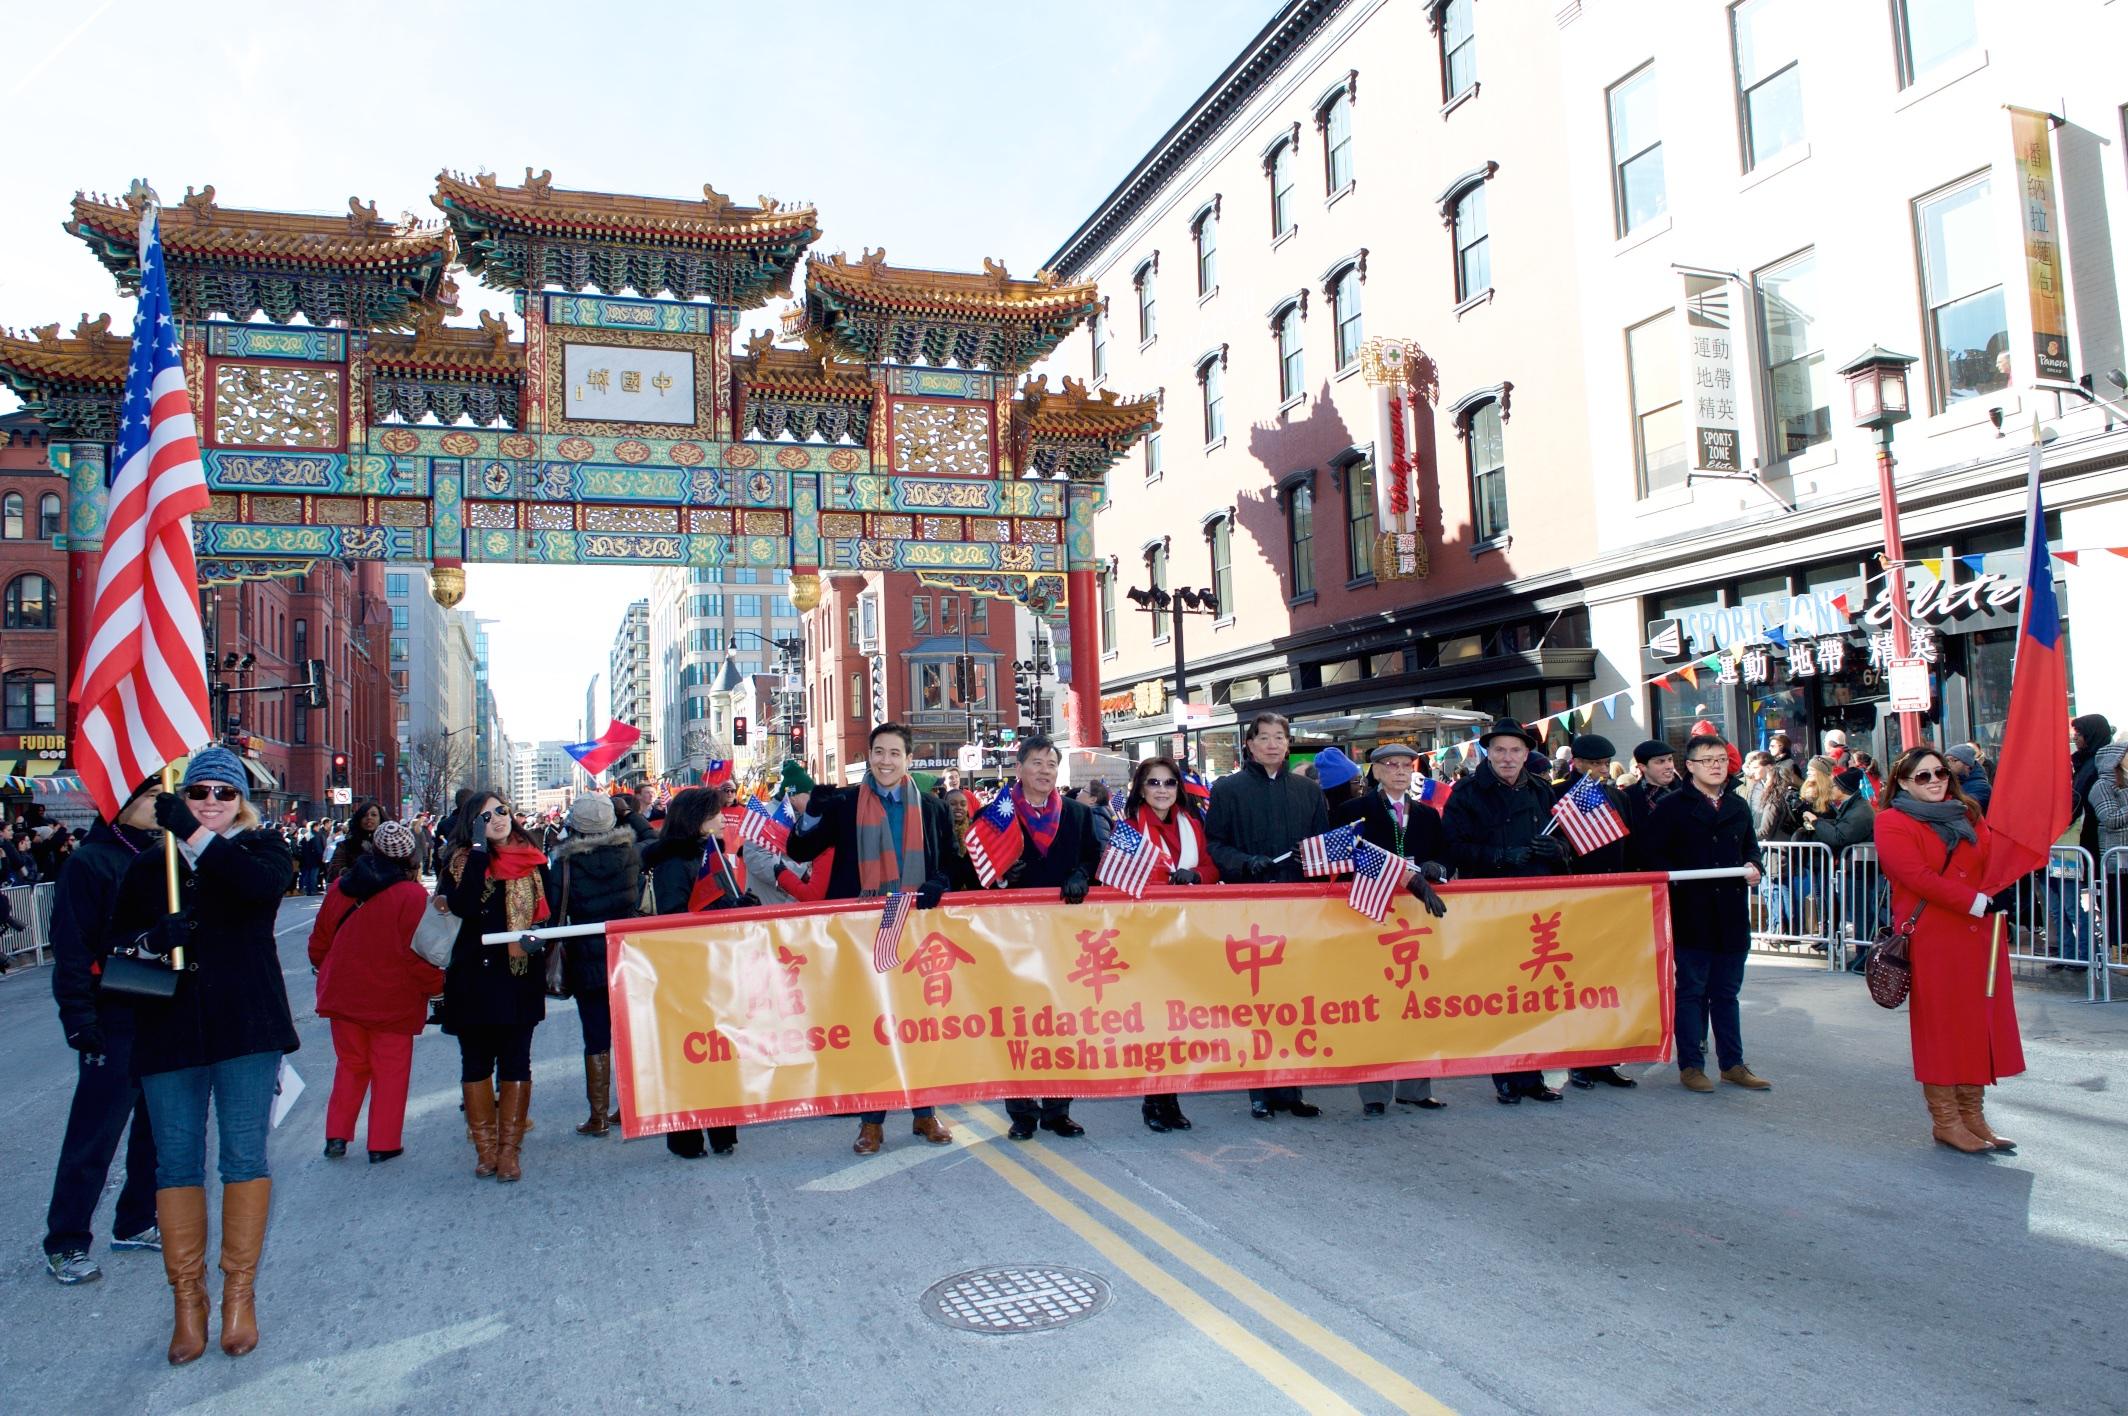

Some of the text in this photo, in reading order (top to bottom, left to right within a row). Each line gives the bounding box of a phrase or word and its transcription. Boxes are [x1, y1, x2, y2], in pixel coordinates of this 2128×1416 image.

[1693, 335, 1729, 360] 運動
[2038, 353, 2069, 369] Panera
[1696, 366, 1731, 391] 地帶
[1698, 396, 1735, 421] 精英
[1703, 431, 1733, 447] SPORTS
[1708, 446, 1731, 461] ZONE
[1397, 533, 1418, 574] 藥房
[1687, 571, 2023, 656] SPORTS ZONE Elite
[1716, 651, 1768, 685] 運動
[1788, 638, 1846, 677] 地帶
[873, 1002, 1146, 1046] Consolidated
[1166, 993, 1380, 1032] Benevolent
[1400, 981, 1620, 1020] Association
